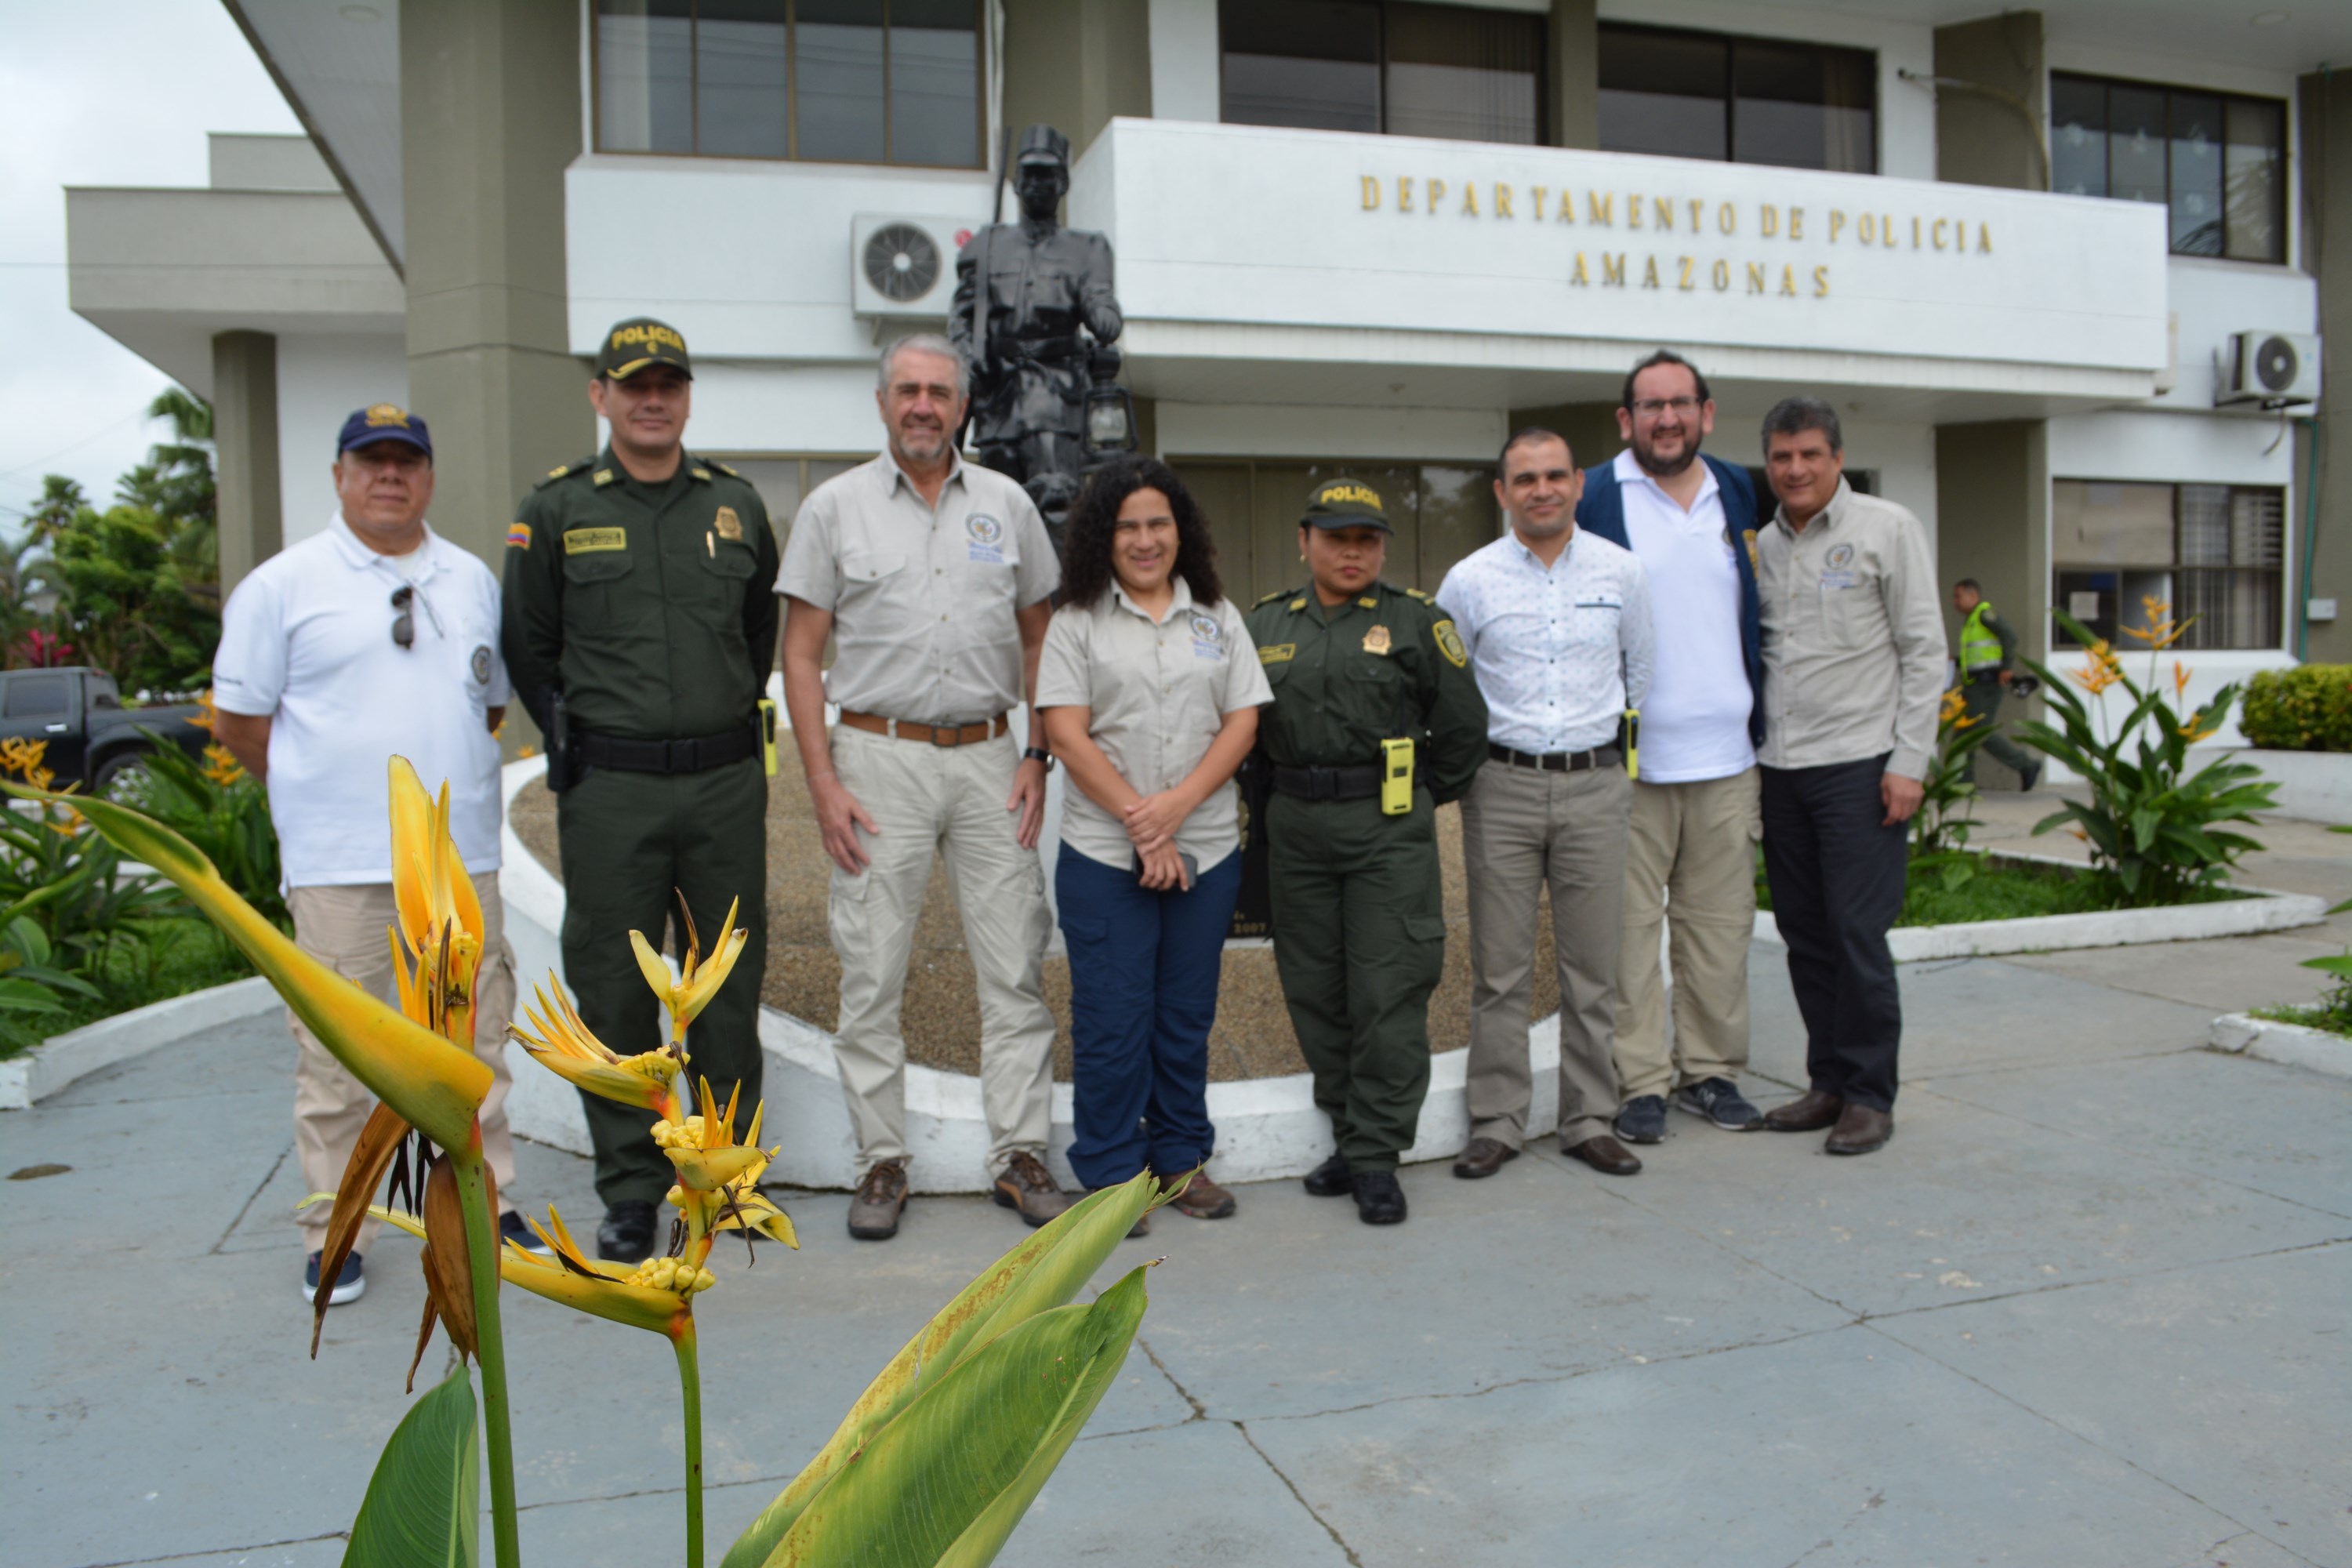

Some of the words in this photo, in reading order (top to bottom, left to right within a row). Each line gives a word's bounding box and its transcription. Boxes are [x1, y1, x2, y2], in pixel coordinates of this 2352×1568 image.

[1361, 175, 1735, 235] DEPARTAMENTO
[1761, 203, 1806, 240] DE
[1829, 209, 1991, 253] POLICIA
[1570, 250, 1829, 296] AMAZONAS
[612, 325, 684, 352] POLICIA
[1320, 486, 1382, 510] POLICIA
